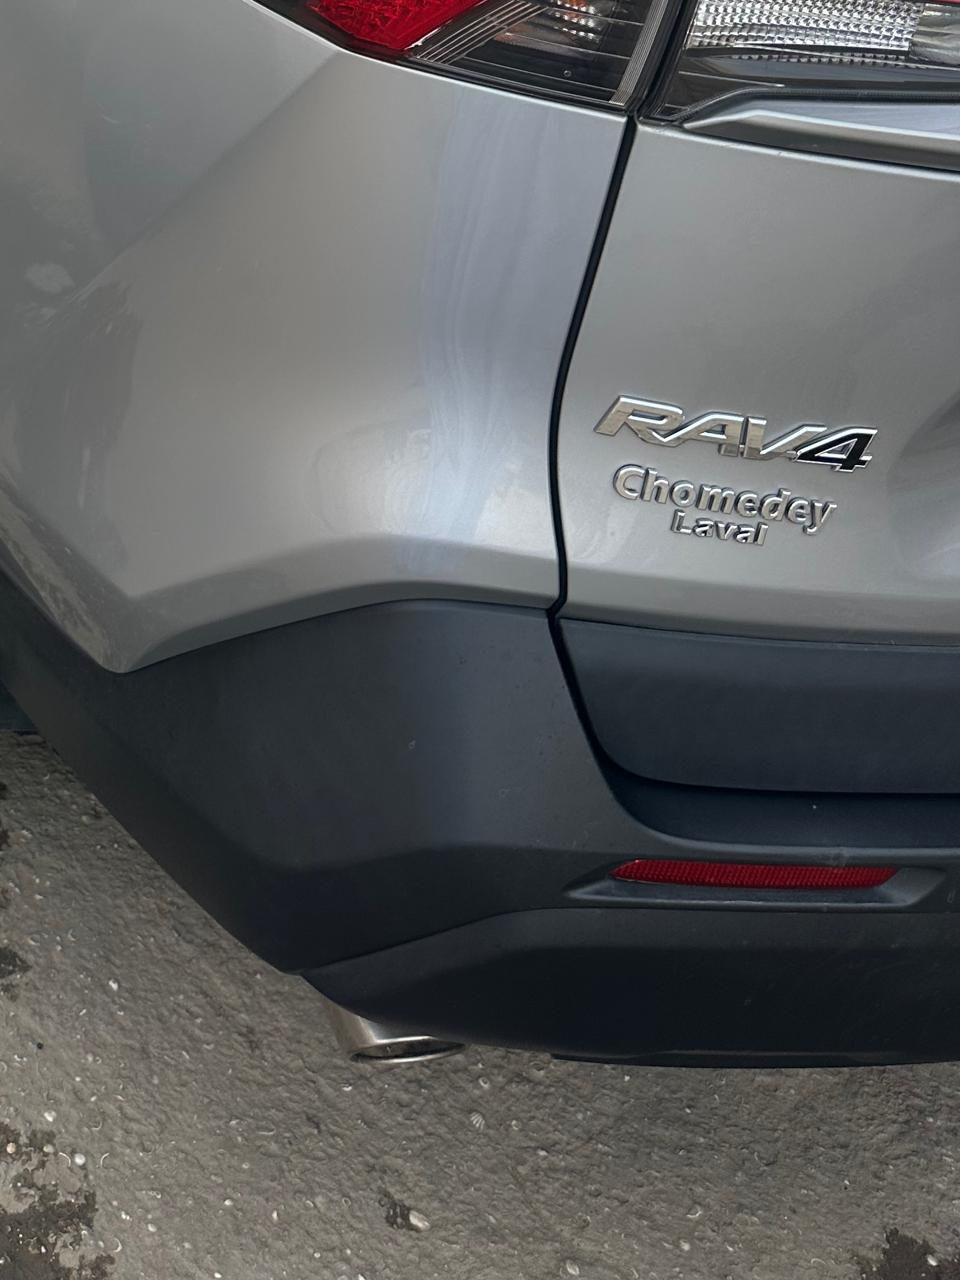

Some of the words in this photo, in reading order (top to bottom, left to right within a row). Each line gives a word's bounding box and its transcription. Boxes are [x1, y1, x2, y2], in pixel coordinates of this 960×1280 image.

[593, 394, 879, 474] RAV4
[612, 463, 838, 537] Chomedey
[669, 508, 770, 547] Laval
